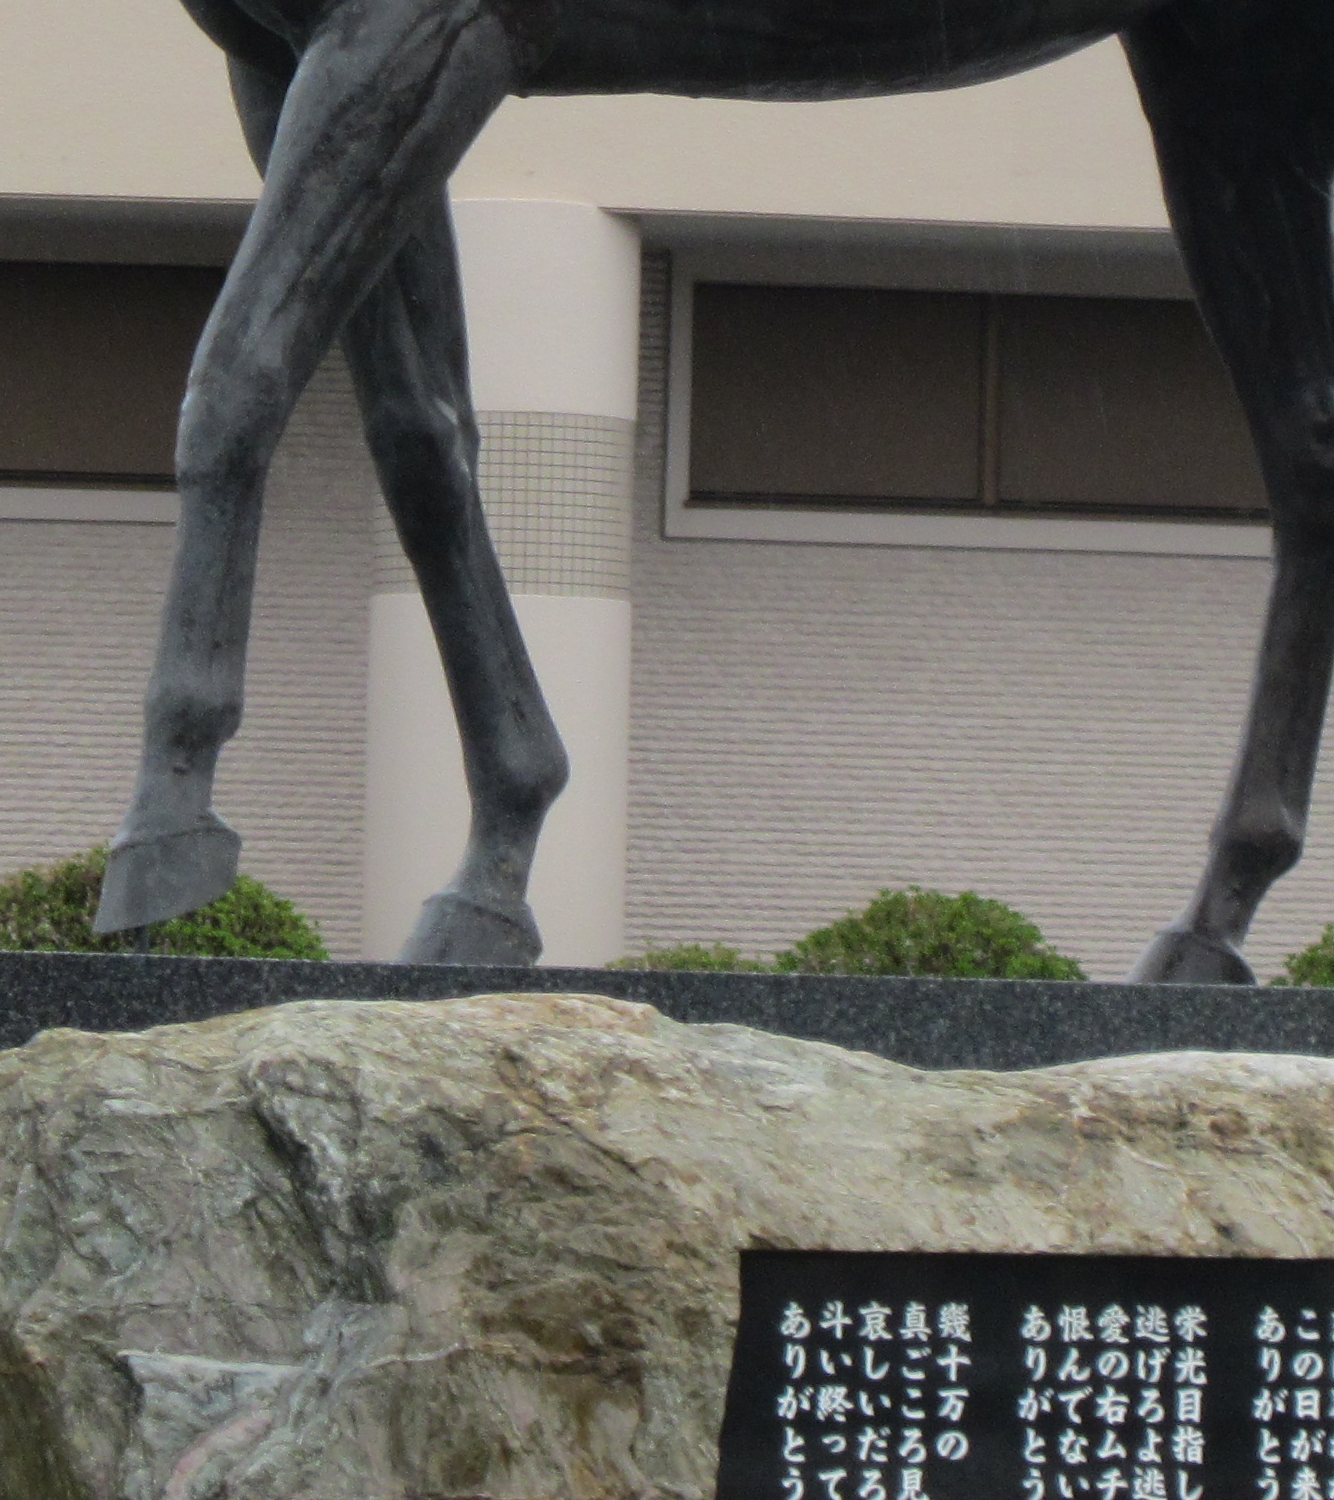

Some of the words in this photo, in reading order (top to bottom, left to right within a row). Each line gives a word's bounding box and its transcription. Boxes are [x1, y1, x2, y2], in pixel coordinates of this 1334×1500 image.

[777, 1302, 814, 1500] ありがとう
[817, 1301, 854, 1500] 斗い終って
[858, 1301, 892, 1500] 哀しいだろ
[897, 1302, 932, 1500] 真ごころ見
[936, 1302, 971, 1460] 幾十万の
[1018, 1305, 1054, 1500] ありがとう
[1058, 1305, 1094, 1498] 恨んでない
[1096, 1304, 1130, 1500] 愛の右ムチ
[1132, 1305, 1171, 1500] 逃げろよ逃
[1172, 1306, 1207, 1500] 栄光目指し
[1253, 1306, 1288, 1500] ありがとう
[1290, 1310, 1326, 1500] この日が来
